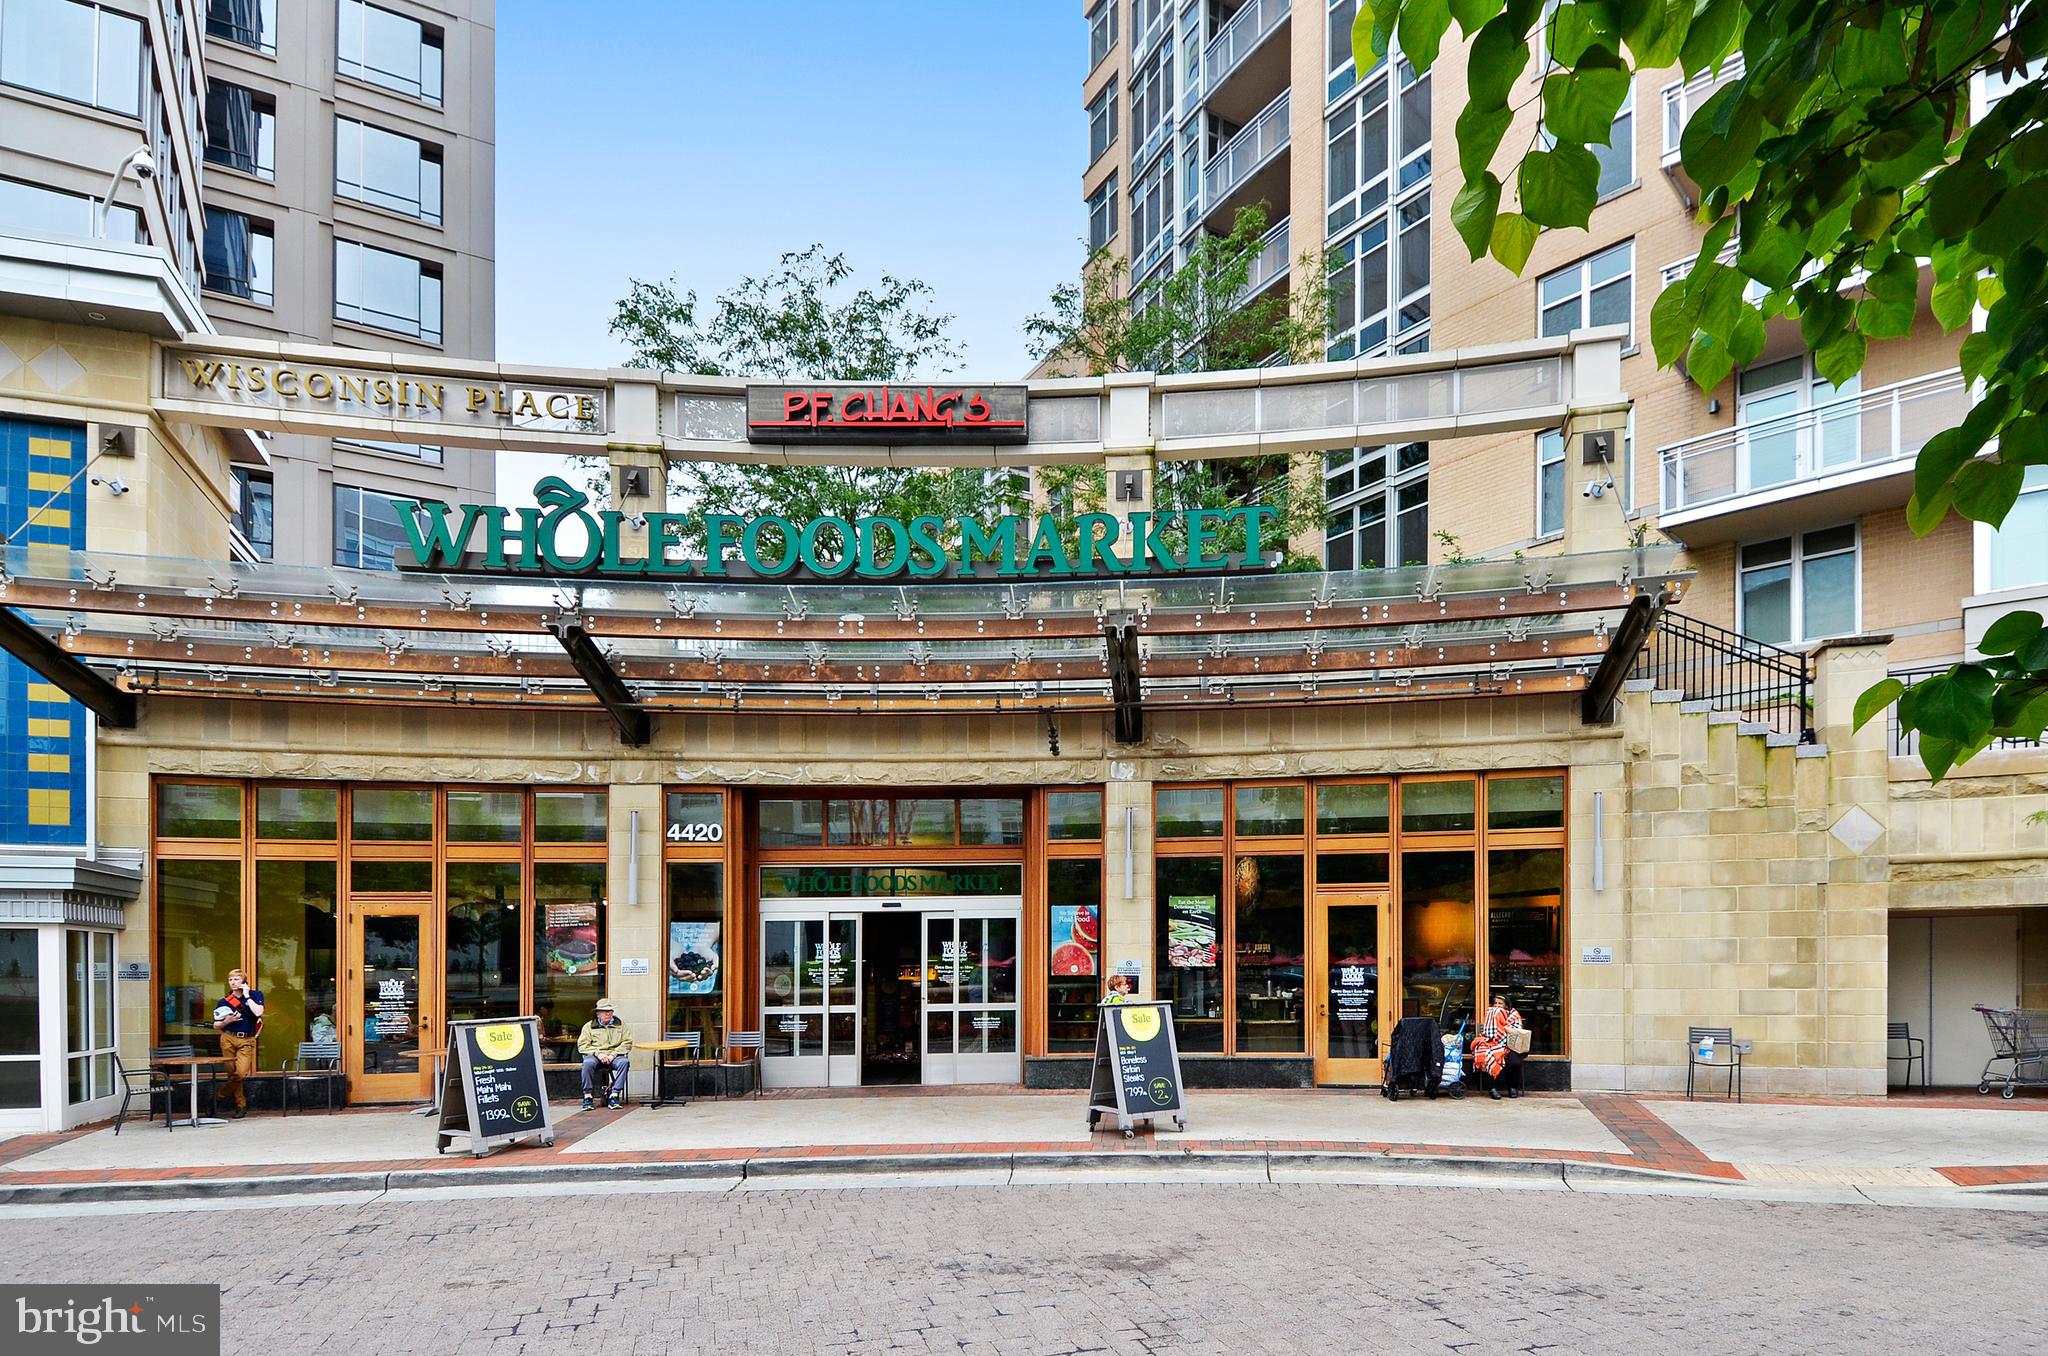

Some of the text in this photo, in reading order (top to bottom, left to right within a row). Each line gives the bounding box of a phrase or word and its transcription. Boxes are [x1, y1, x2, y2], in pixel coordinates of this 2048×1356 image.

[178, 358, 597, 421] WISCONSIN PLACE
[391, 476, 1277, 578] WHOLE FOODS MARKET
[667, 823, 722, 842] 4420
[783, 868, 1001, 892] WHOLE FOODS MARKET
[1132, 1014, 1151, 1024] Sale
[489, 1031, 513, 1042] Sale
[474, 1075, 496, 1086] Fresh
[476, 1081, 512, 1095] Mahi Mahi
